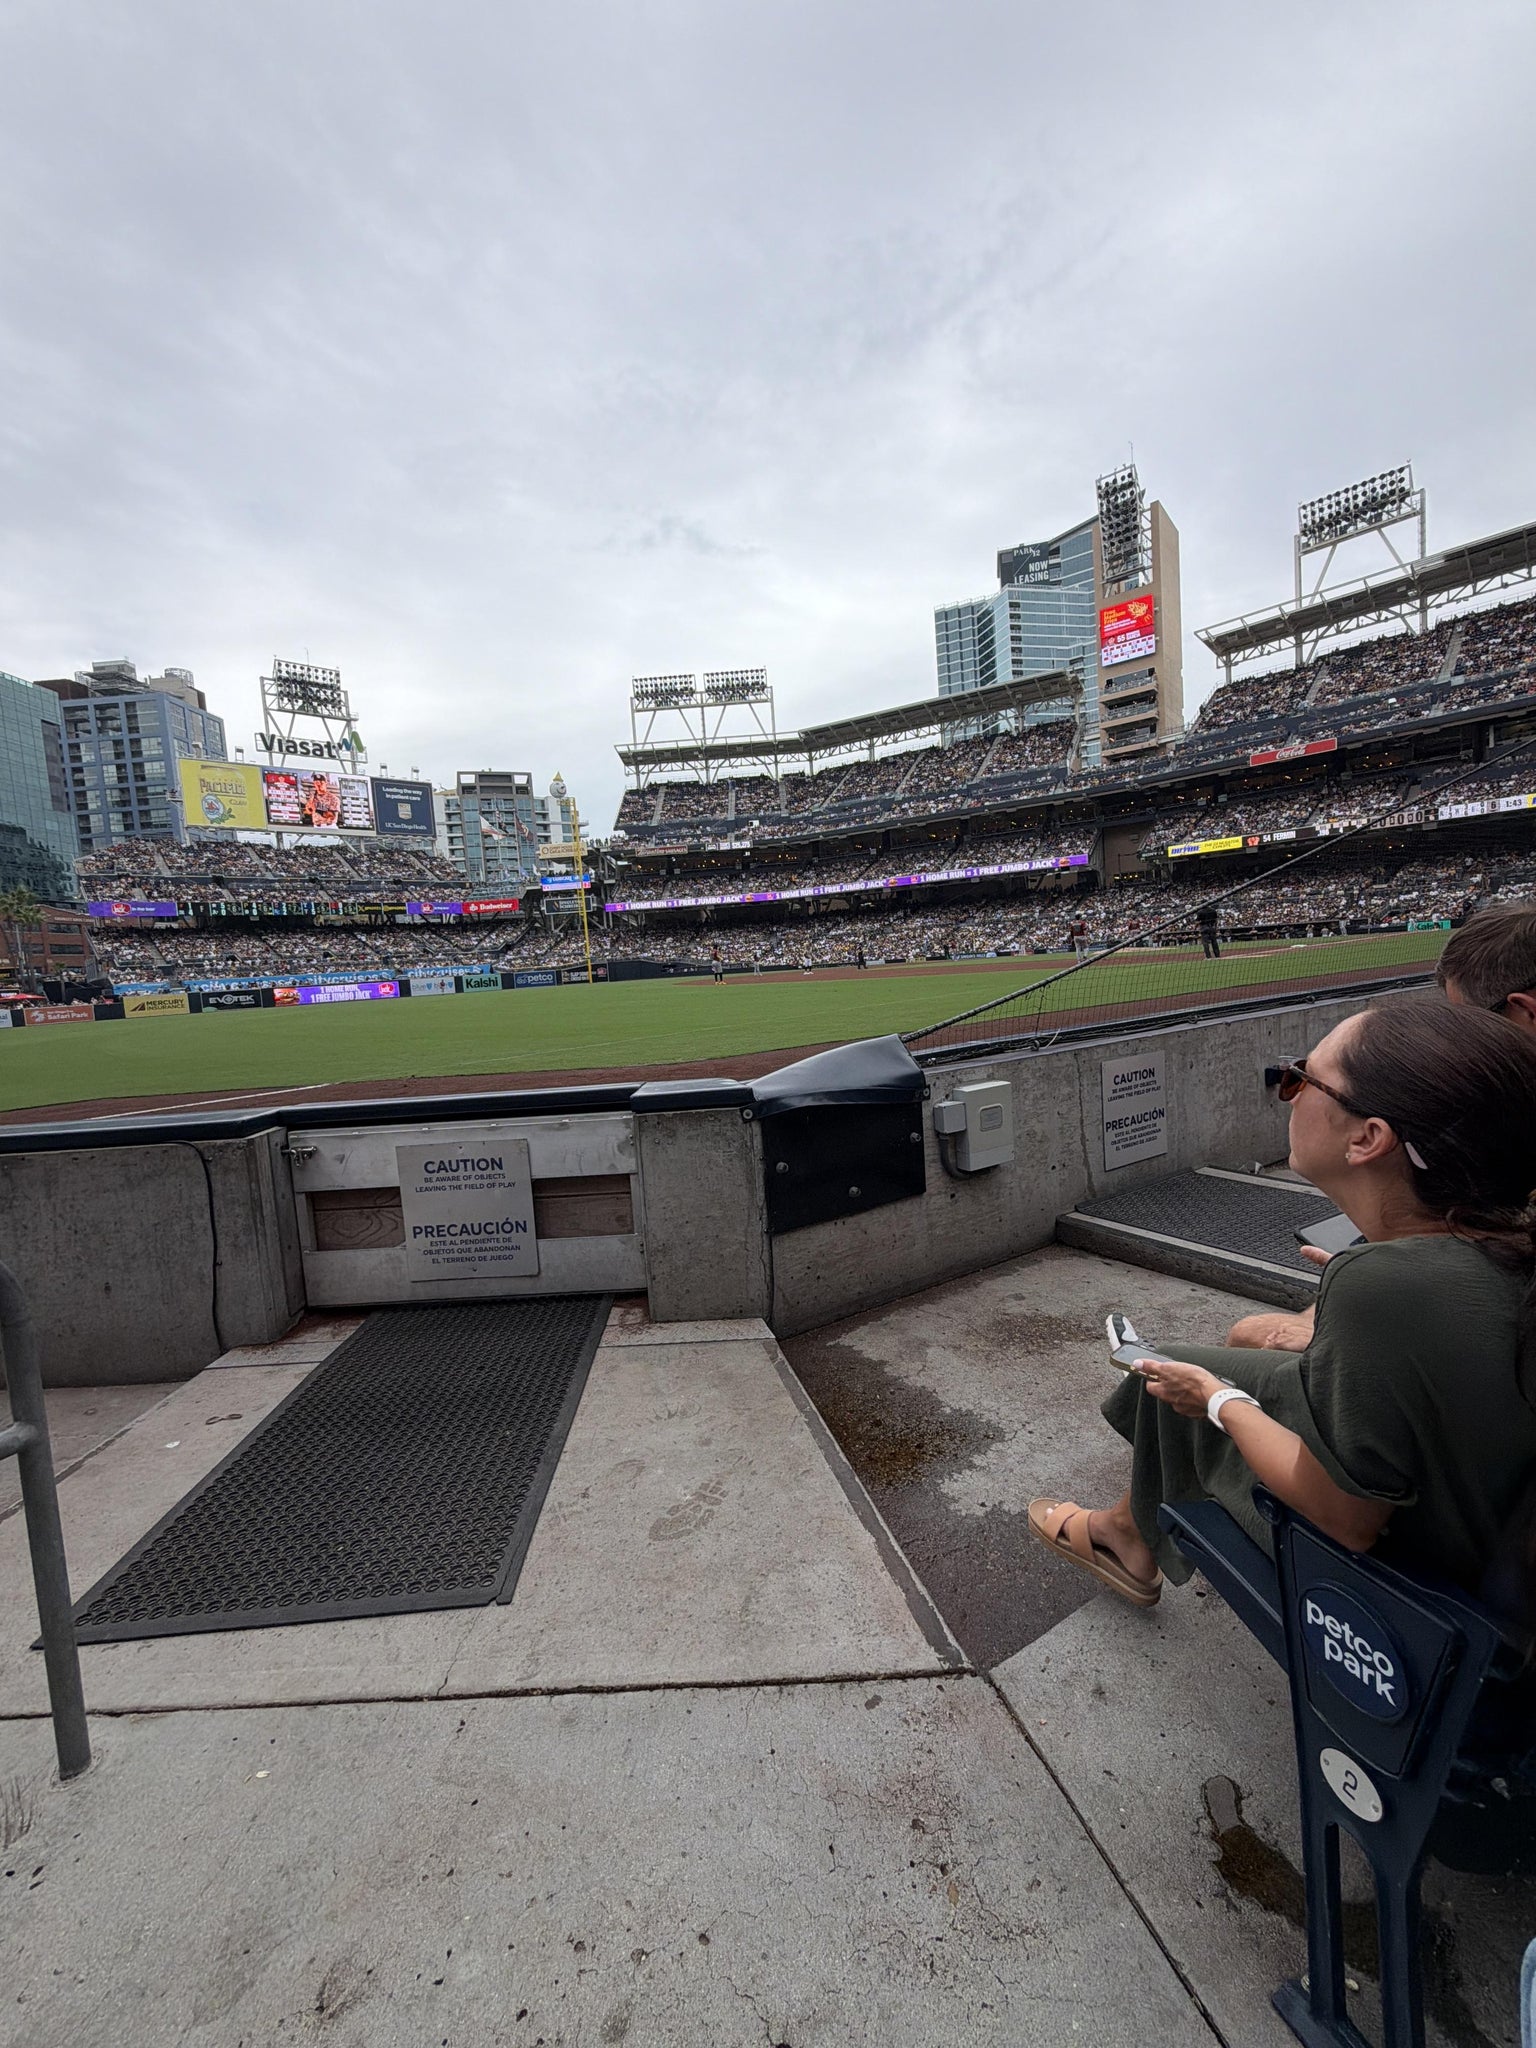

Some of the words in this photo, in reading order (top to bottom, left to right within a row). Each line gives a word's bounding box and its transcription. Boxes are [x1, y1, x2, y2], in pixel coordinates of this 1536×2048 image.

[1029, 560, 1048, 572] NOW
[1014, 571, 1049, 585] LEASING
[259, 732, 337, 759] Viasat
[1491, 801, 1496, 809] 6
[1506, 799, 1522, 808] 1:43
[925, 873, 948, 882] HOME
[949, 871, 965, 879] RUN
[979, 867, 1000, 875] FREE
[1000, 862, 1030, 873] JUMBO
[781, 890, 800, 899] HOME
[800, 889, 814, 897] RUN
[824, 886, 840, 894] FREE
[840, 881, 867, 891] JUMBO
[480, 902, 513, 911] Budweiser
[697, 897, 722, 905] JUMBO
[466, 977, 498, 989] Kalshi
[527, 974, 553, 984] petco
[325, 985, 344, 993] HOME
[145, 998, 184, 1006] MERCURY
[209, 994, 254, 1004] EVOTEK
[316, 993, 331, 1003] FREE
[332, 991, 354, 1002] JUMBO
[47, 1012, 70, 1020] Safari
[1113, 1067, 1155, 1085] CAUTION
[1105, 1107, 1164, 1132] PRECAUCIÓN
[424, 1157, 504, 1174] CAUTION
[435, 1175, 460, 1183] AWARE
[415, 1185, 447, 1193] LEAVING
[412, 1217, 528, 1239] PRECAUCIÓN
[430, 1240, 447, 1248] ESTE
[460, 1237, 501, 1245] PENDIENTE
[423, 1248, 455, 1256] OBJETOS
[474, 1245, 521, 1253] ABANDONAN
[442, 1256, 476, 1264] TERRENO
[1306, 1598, 1394, 1678] petco
[1324, 1634, 1397, 1708] park
[1343, 1770, 1358, 1801] 2
